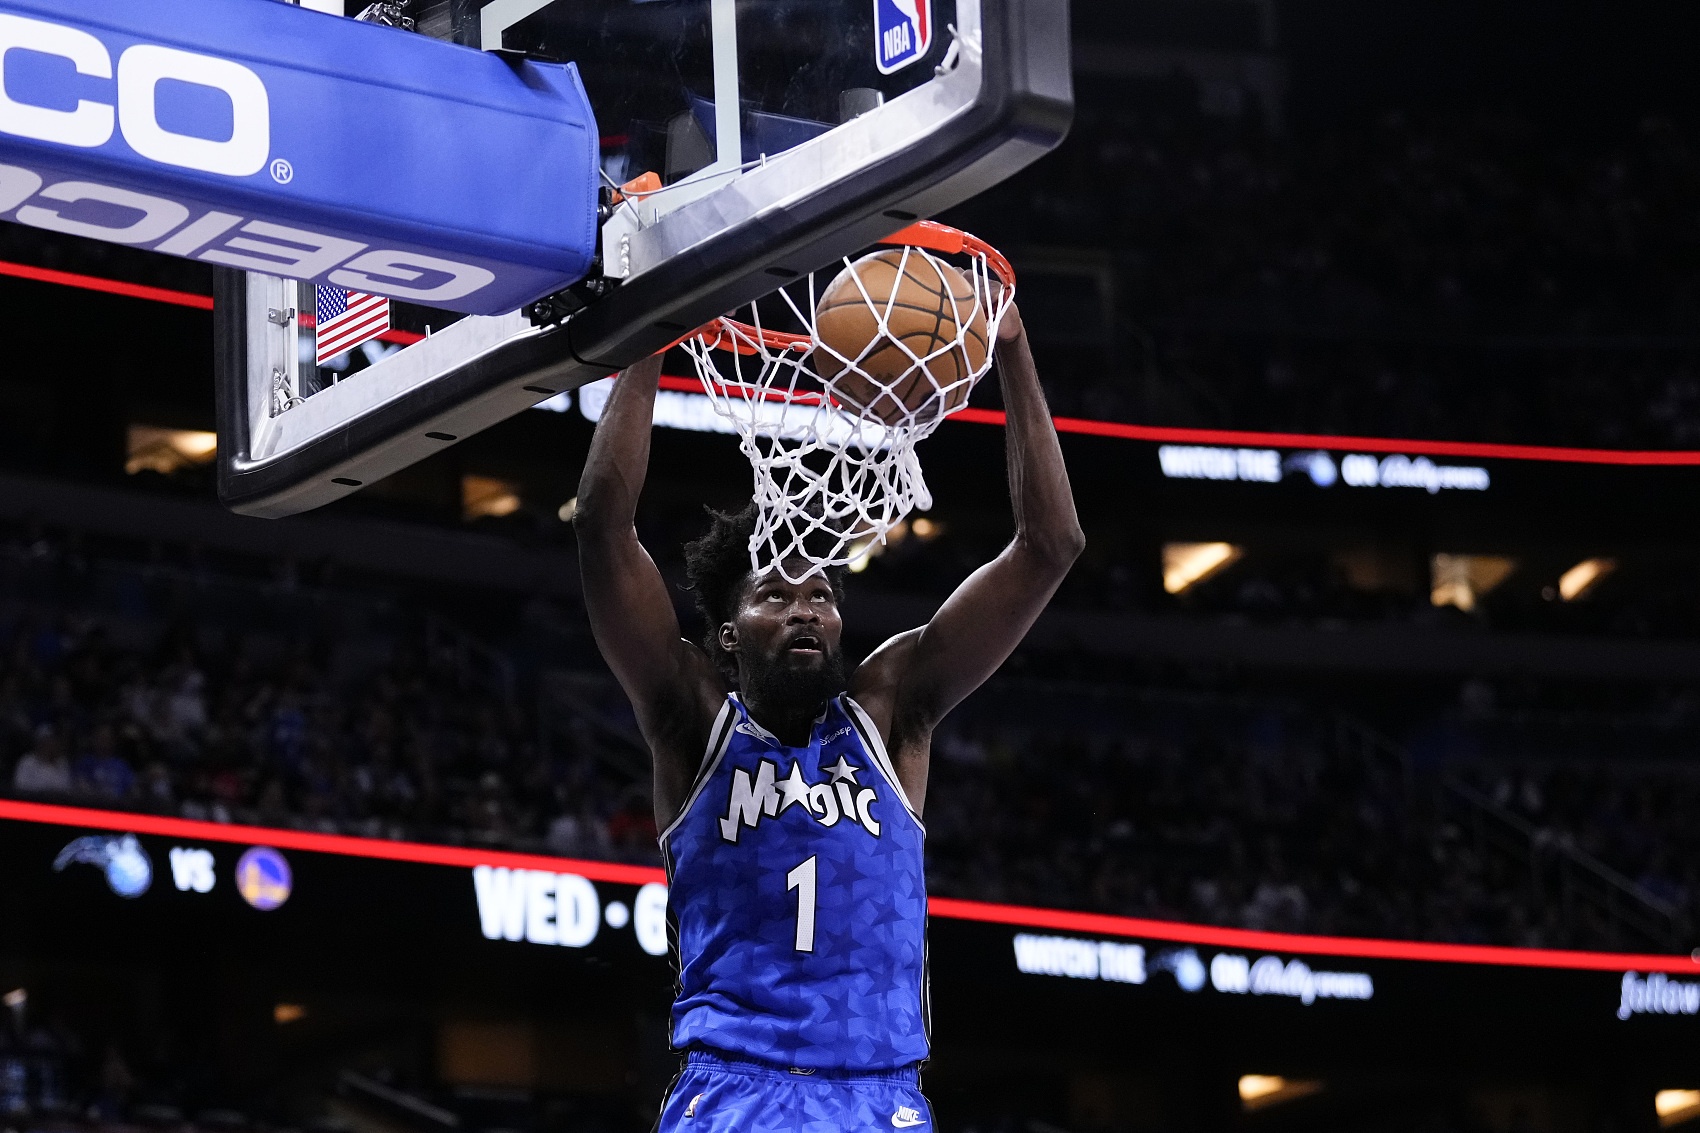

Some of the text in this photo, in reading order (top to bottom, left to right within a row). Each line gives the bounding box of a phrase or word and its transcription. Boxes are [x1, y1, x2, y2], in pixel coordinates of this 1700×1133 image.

[884, 21, 911, 61] NBA
[0, 163, 496, 302] GEIC
[719, 755, 881, 844] Magic
[169, 846, 216, 894] VS
[474, 865, 600, 948] WED
[786, 854, 817, 953] 1
[897, 1105, 920, 1122] NIKE
